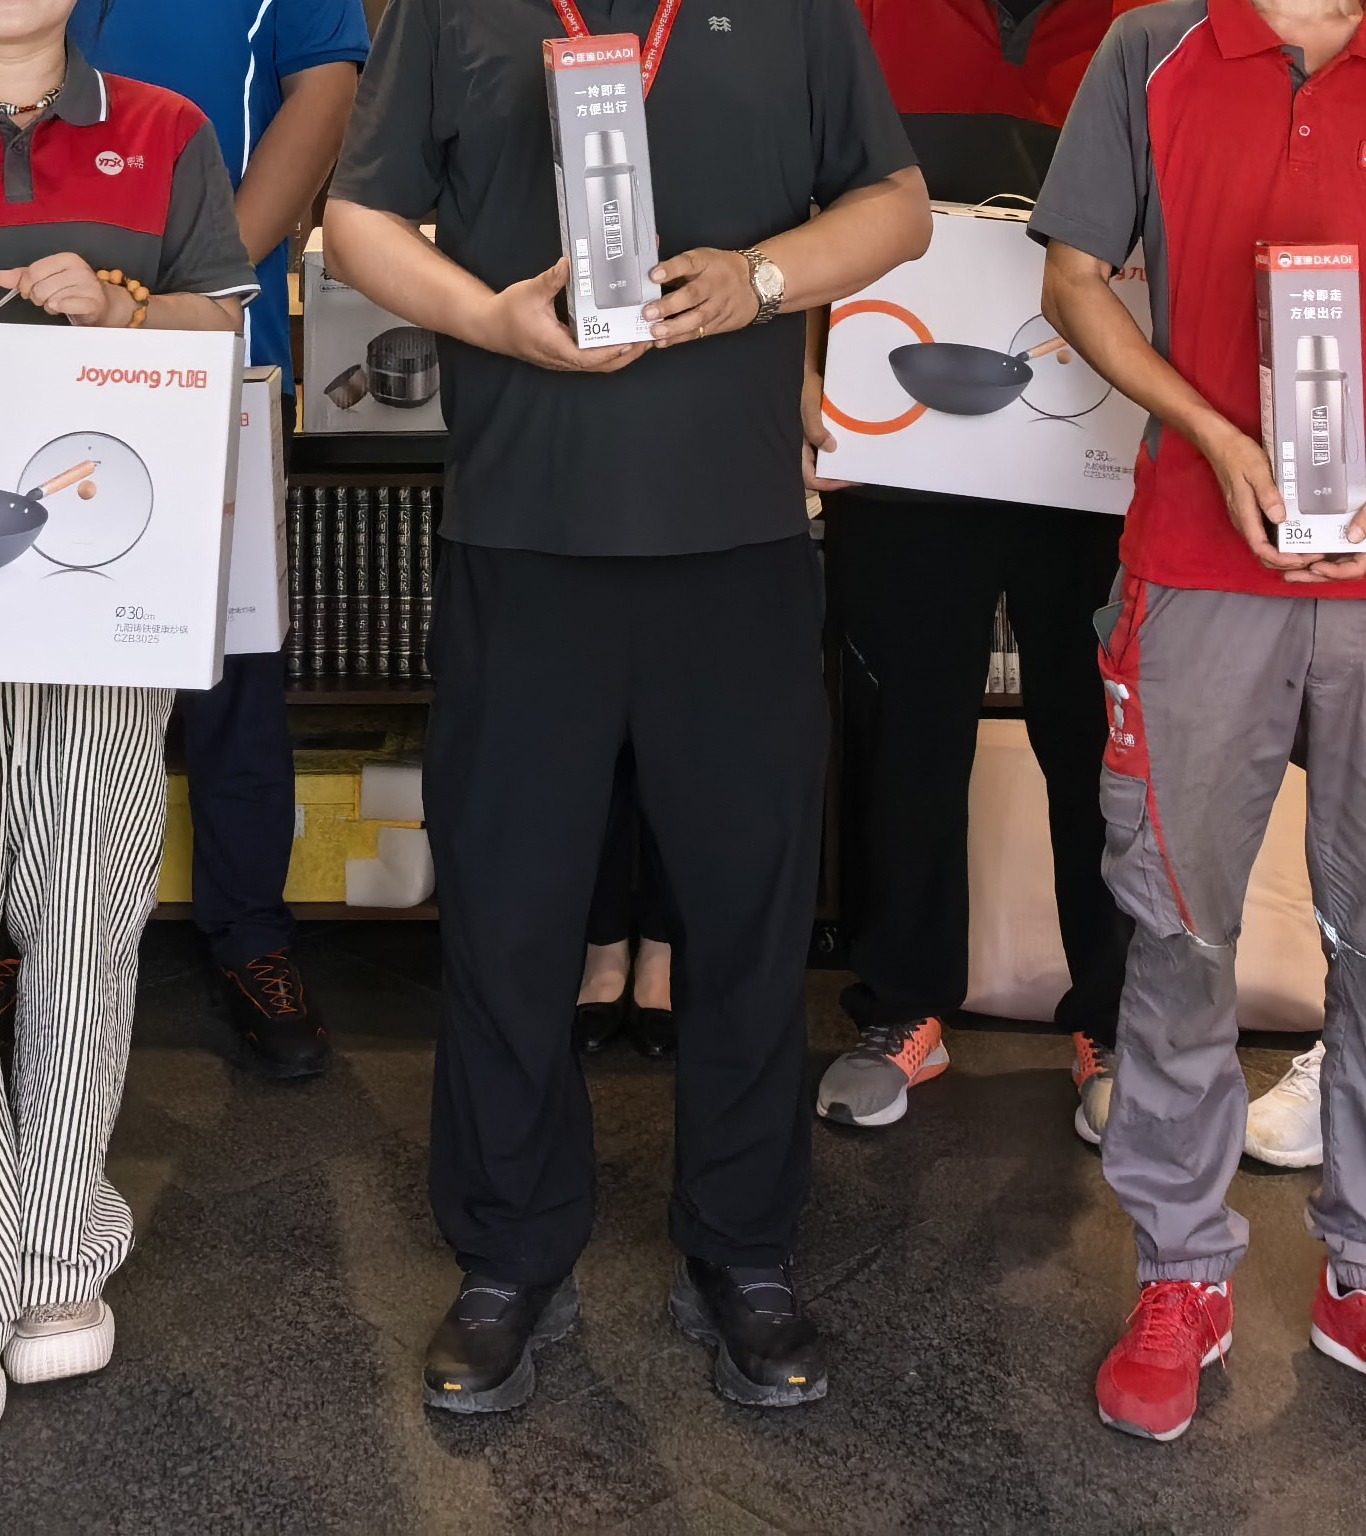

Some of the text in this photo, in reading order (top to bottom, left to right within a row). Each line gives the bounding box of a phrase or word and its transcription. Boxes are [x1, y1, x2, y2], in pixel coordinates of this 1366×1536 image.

[597, 48, 634, 61] D.KADI
[574, 83, 627, 98] 一拎即走
[576, 100, 628, 117] 方便出行
[1314, 255, 1352, 265] D.KADI
[1290, 289, 1342, 302] 一拎即走
[1290, 307, 1343, 320] 方便出行
[583, 322, 611, 336] 304
[76, 364, 208, 390] Joyoung 九阳
[1285, 528, 1313, 540] 304
